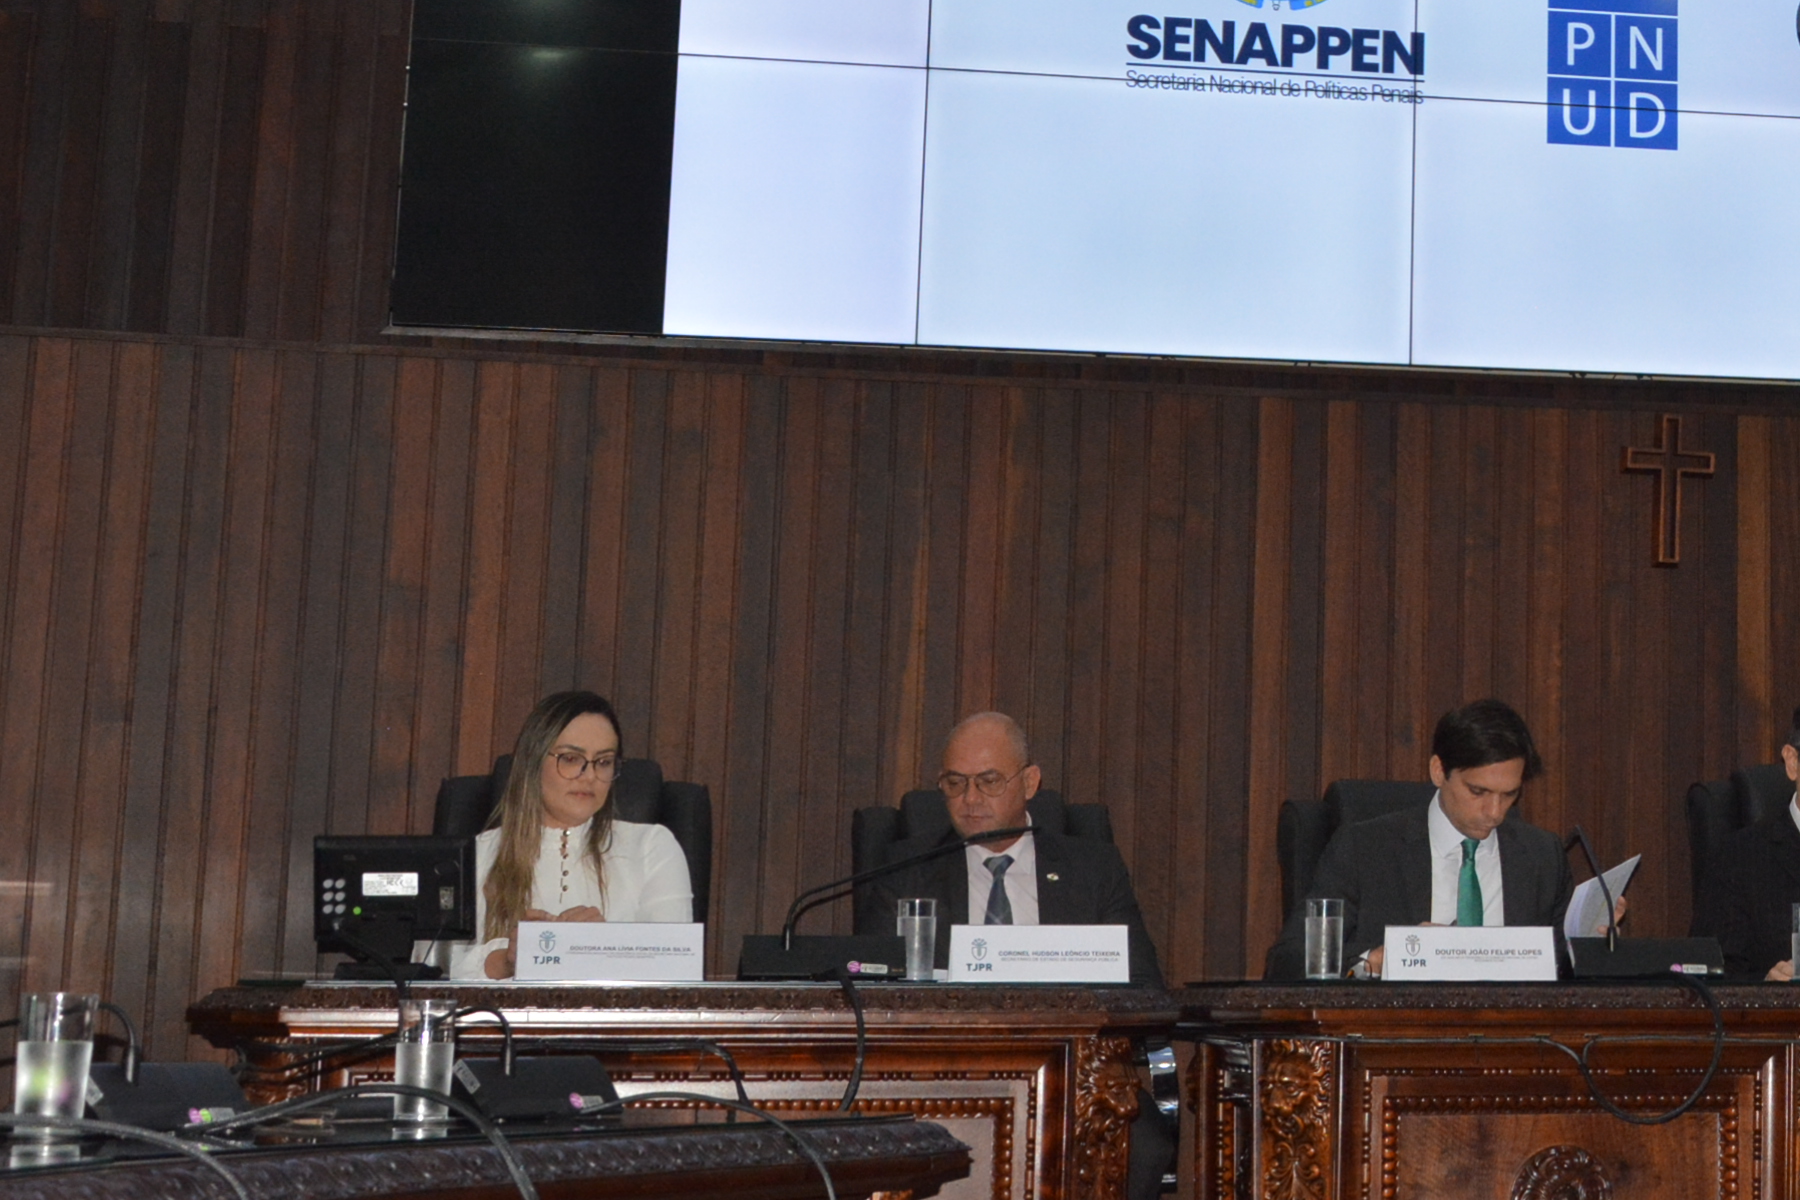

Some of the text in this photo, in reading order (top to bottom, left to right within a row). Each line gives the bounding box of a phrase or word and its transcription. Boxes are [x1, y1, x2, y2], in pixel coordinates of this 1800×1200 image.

[1125, 13, 1426, 76] SENAPPEN
[1125, 69, 1425, 105] Secretaria Nacional de Políticas Penais
[1435, 948, 1466, 956] DOUTOR
[1490, 948, 1516, 956] FELIPE
[1517, 948, 1543, 956] LOPES
[532, 955, 561, 965] TJPR
[1401, 958, 1427, 968] TJPR
[966, 962, 993, 972] TJPR
